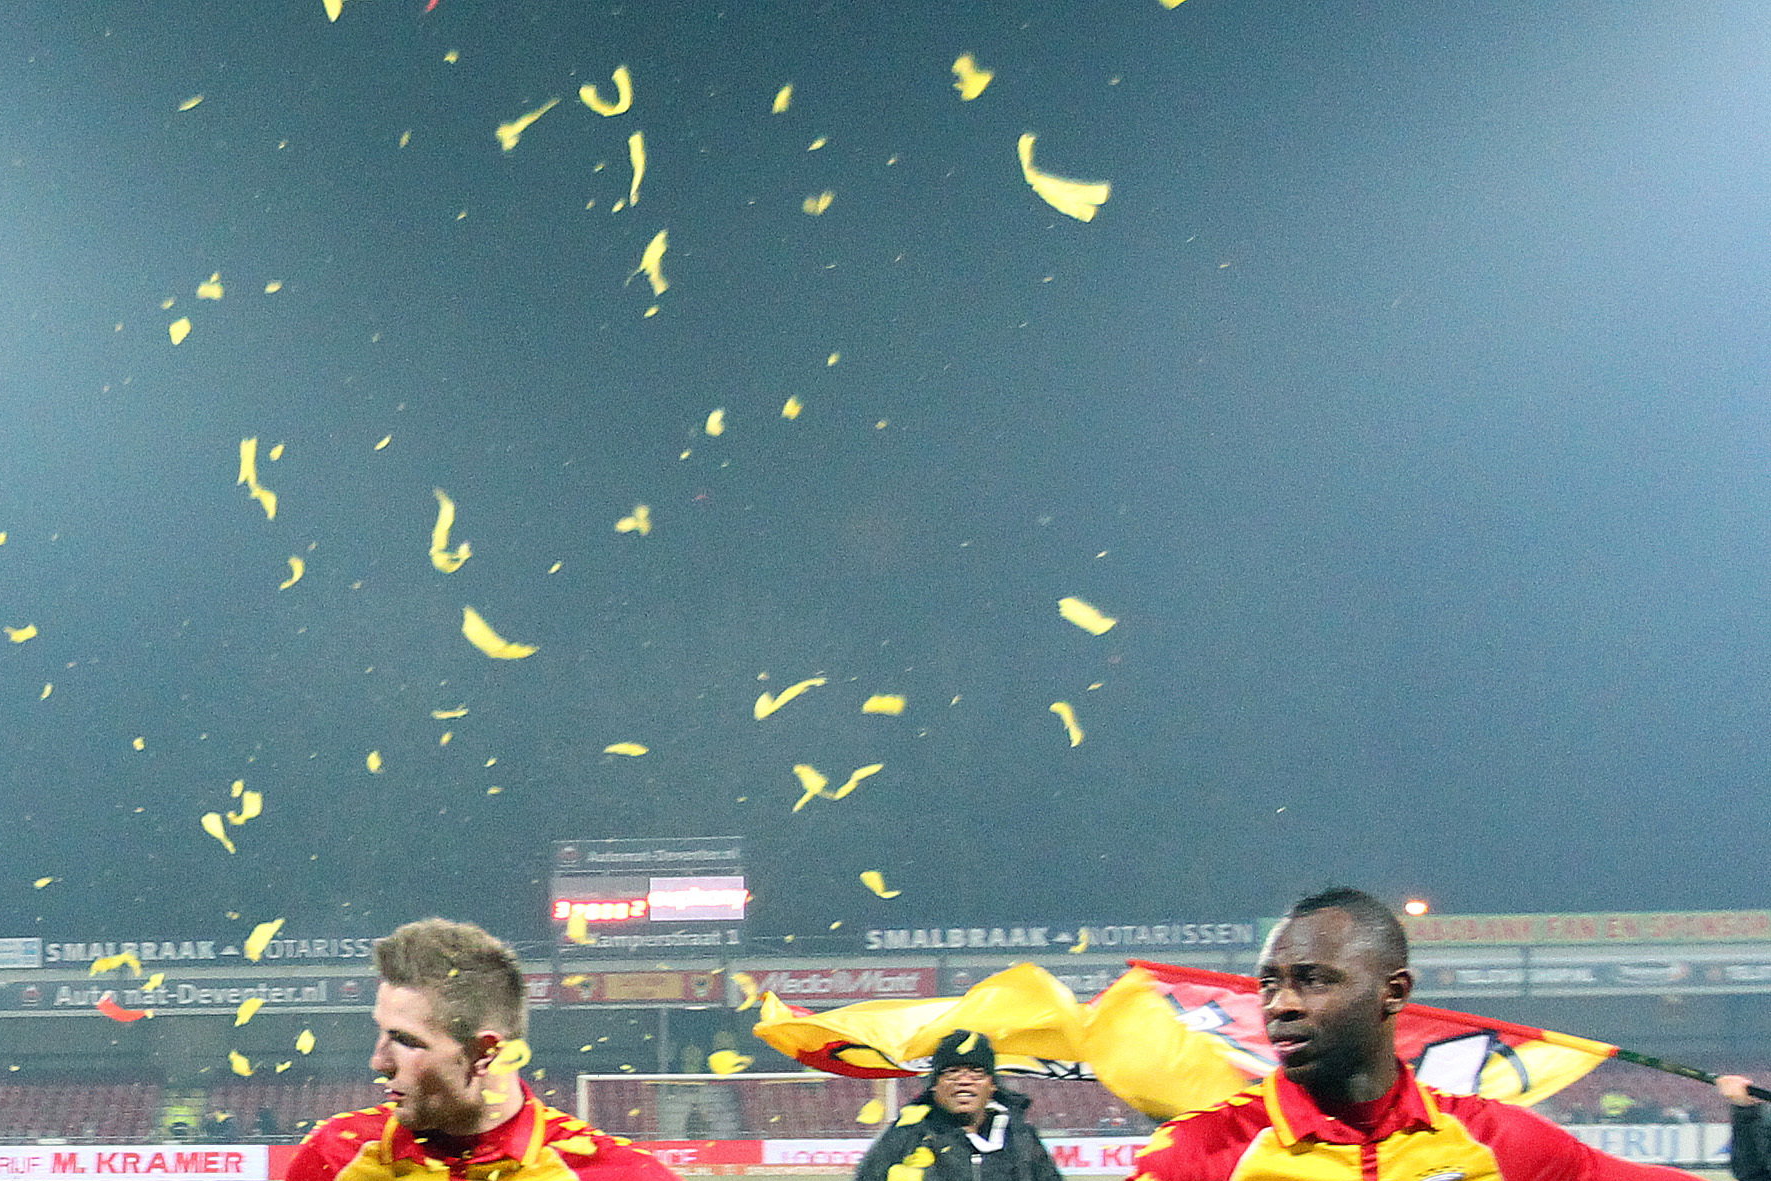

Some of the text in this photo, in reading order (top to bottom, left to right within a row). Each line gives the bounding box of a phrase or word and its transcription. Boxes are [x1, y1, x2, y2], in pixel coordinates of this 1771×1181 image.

[866, 928, 1050, 949] SMALBRAAK
[52, 1151, 86, 1174] M.
[95, 1151, 243, 1174] KRAMER
